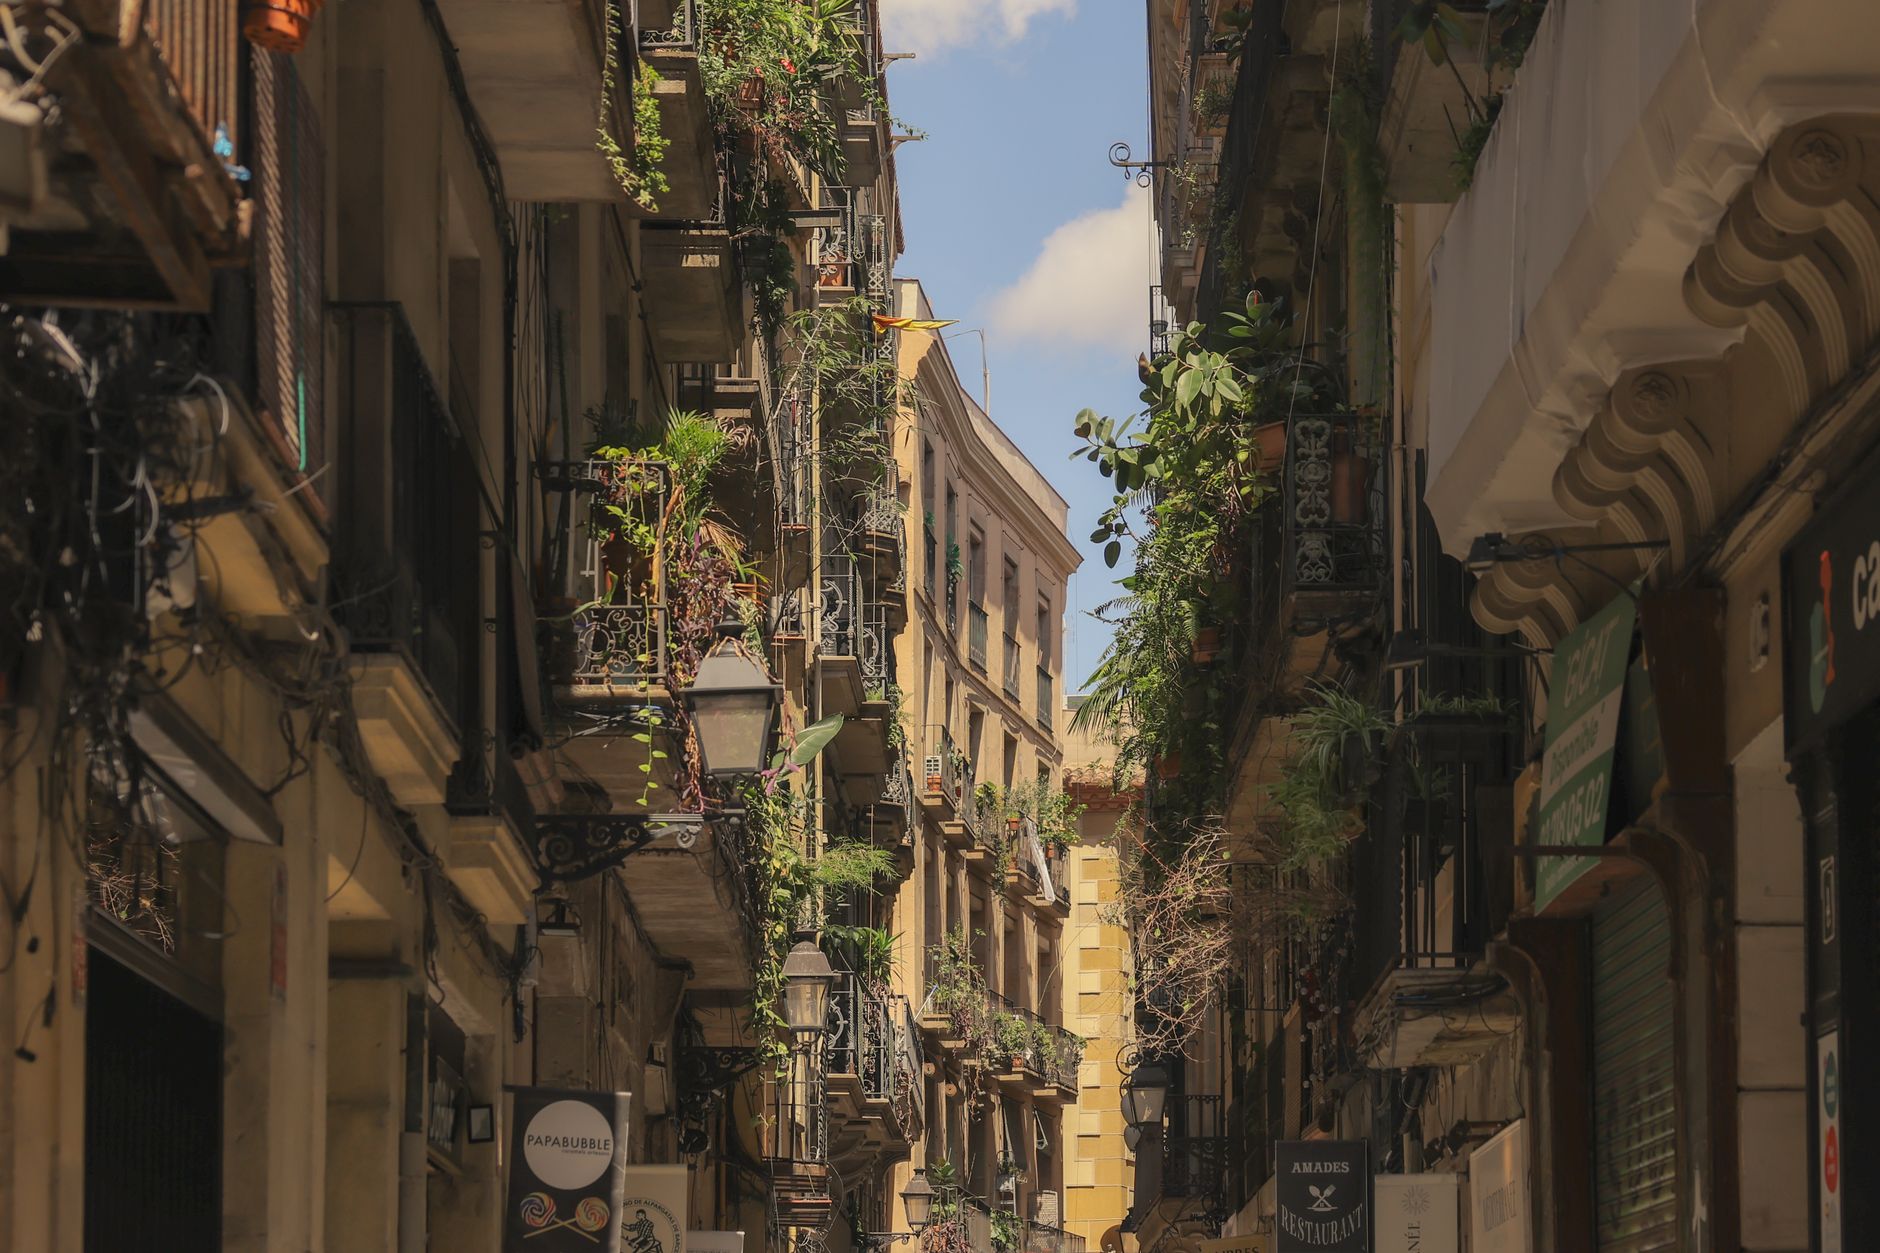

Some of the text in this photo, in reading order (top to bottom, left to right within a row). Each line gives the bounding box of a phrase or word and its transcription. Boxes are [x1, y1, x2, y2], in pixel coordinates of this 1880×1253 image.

[1584, 772, 1604, 830] 02
[527, 1134, 610, 1151] PAPABUBBLE
[1291, 1161, 1350, 1174] AMADES
[1281, 1202, 1363, 1246] RESTAURANT
